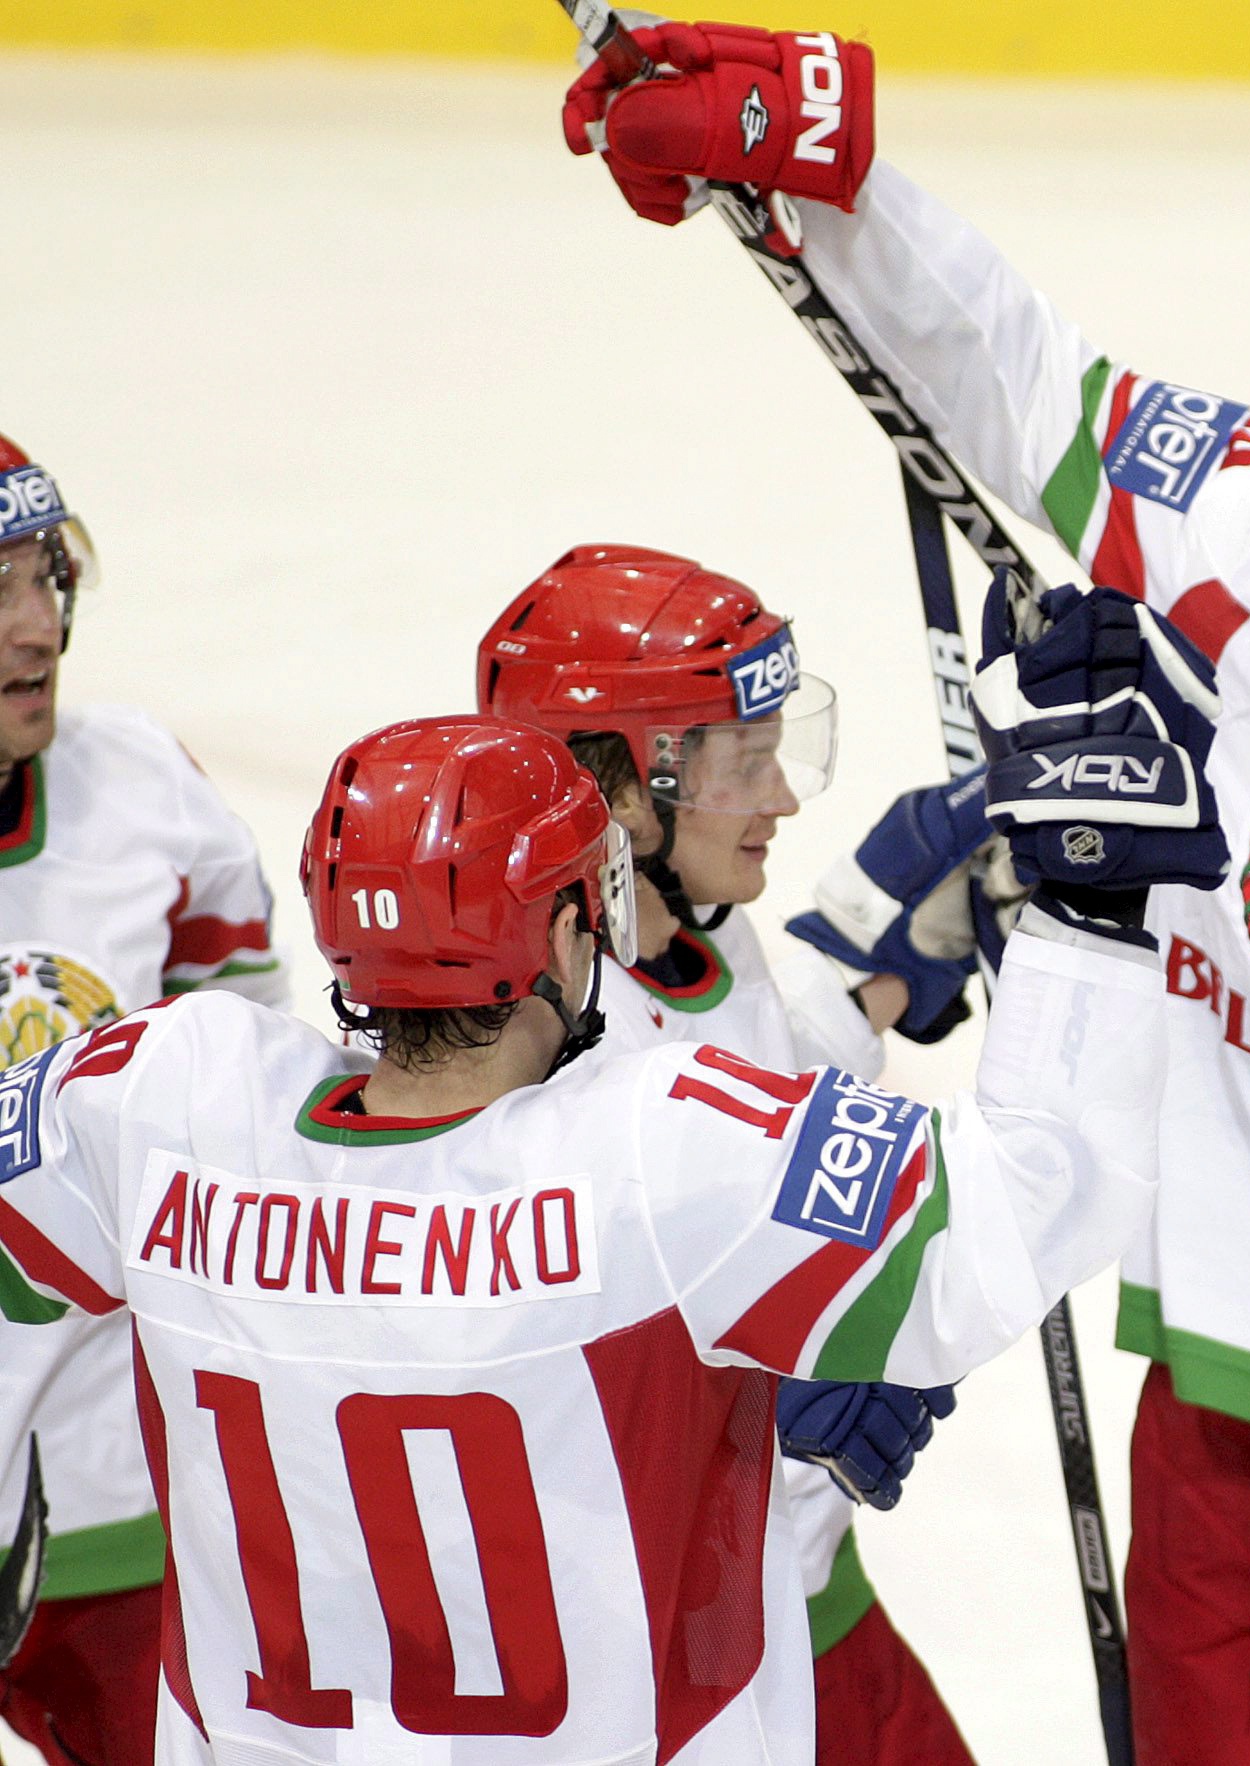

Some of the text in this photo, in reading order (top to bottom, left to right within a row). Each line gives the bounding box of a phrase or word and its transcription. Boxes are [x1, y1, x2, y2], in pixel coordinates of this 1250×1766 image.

[709, 189, 1019, 566] EASTON
[351, 888, 400, 931] 10
[667, 1044, 817, 1139] 10
[140, 1170, 582, 1297] ANTONENKO
[1047, 1303, 1087, 1445] SUPREM
[193, 1368, 568, 1737] 10
